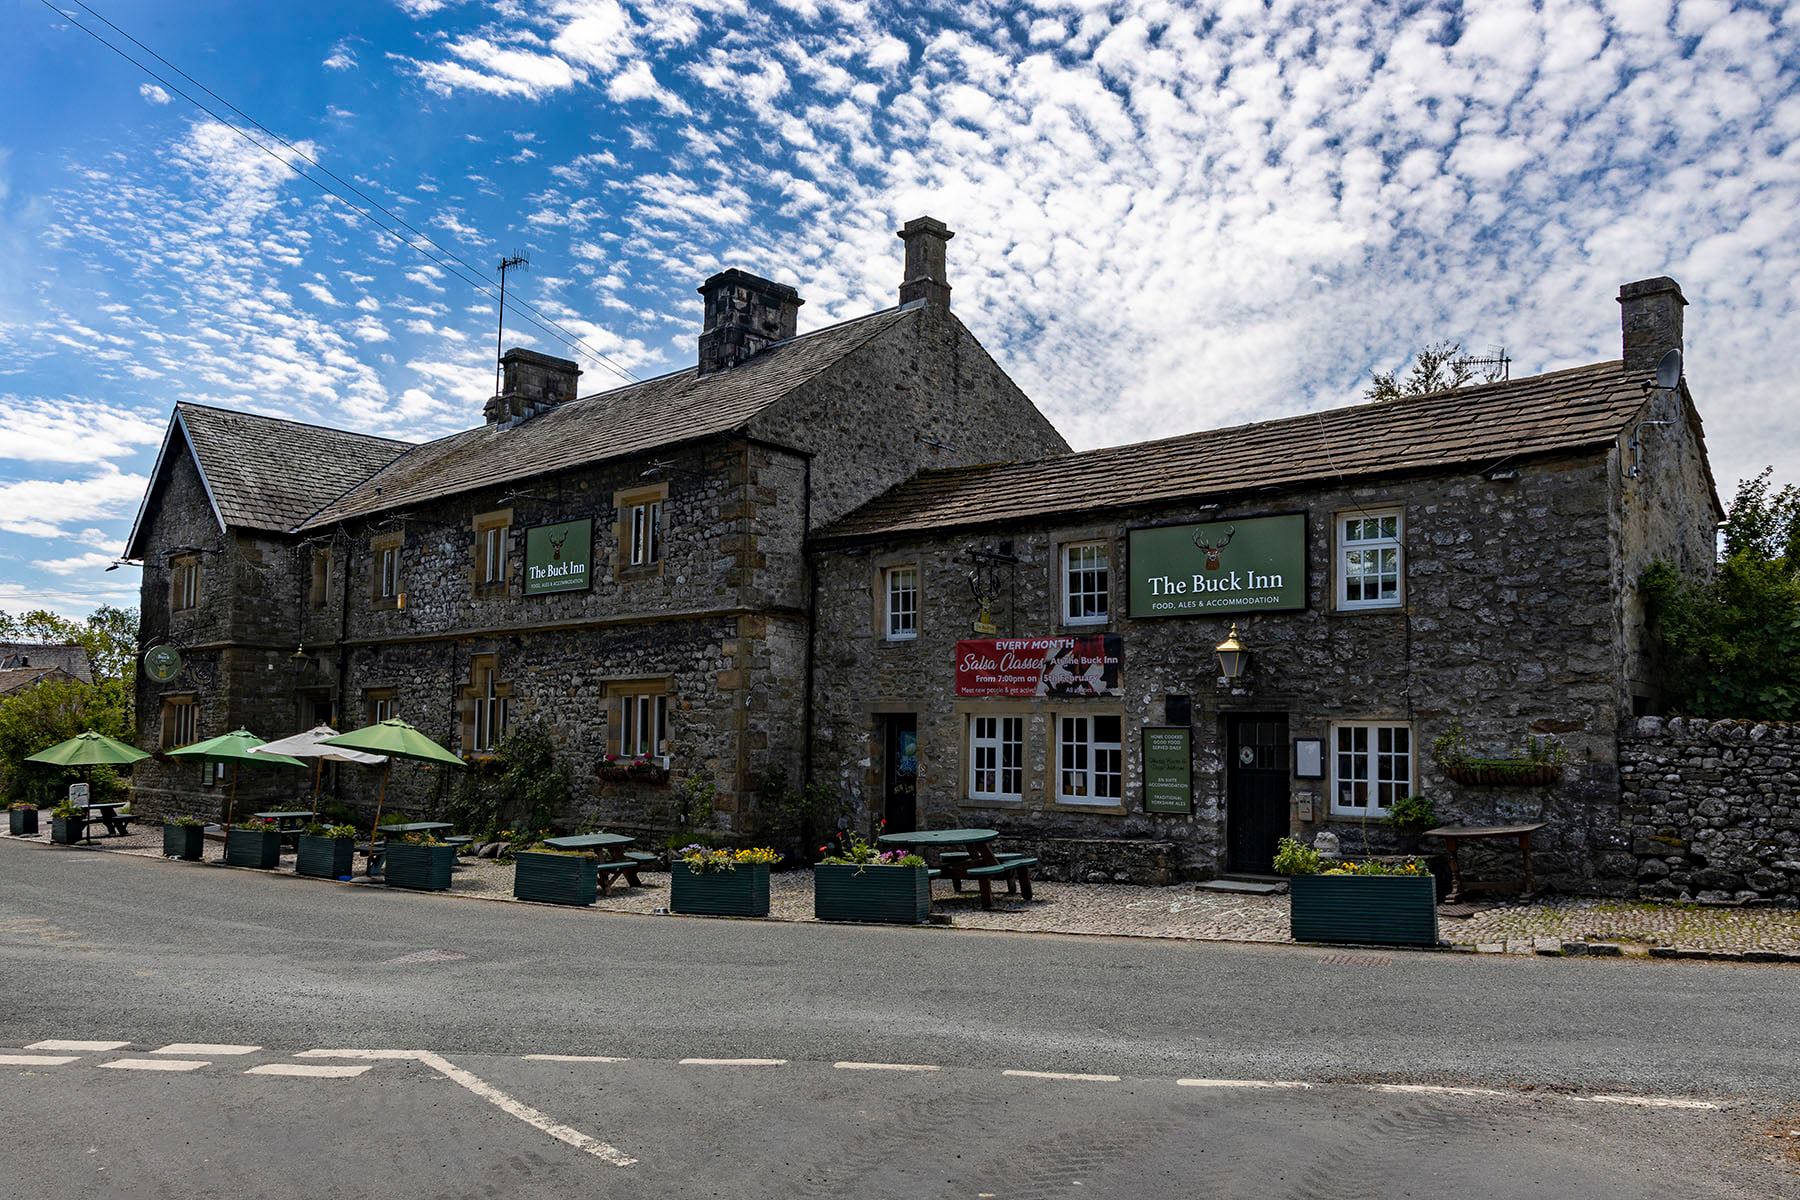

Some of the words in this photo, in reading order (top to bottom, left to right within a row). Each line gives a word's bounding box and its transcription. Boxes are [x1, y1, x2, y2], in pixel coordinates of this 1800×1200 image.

[529, 565, 546, 580] The
[547, 561, 569, 578] Buck
[569, 561, 585, 575] Inn
[1148, 575, 1187, 596] The
[1192, 571, 1243, 593] Buck
[1247, 570, 1284, 589] Inn
[1152, 602, 1176, 610] FOOD,
[1178, 599, 1197, 608] ALES
[1198, 599, 1205, 607] &
[1206, 596, 1280, 607] ACCOMMODATION
[996, 641, 1029, 651] EVERY
[1031, 639, 1075, 650] MONTH
[959, 653, 998, 673] Salsa
[999, 652, 1045, 673] Classes
[1050, 657, 1061, 665] At
[1081, 656, 1102, 665] Buck
[1104, 656, 1118, 664] Inn
[997, 675, 1026, 684] 7:00pm
